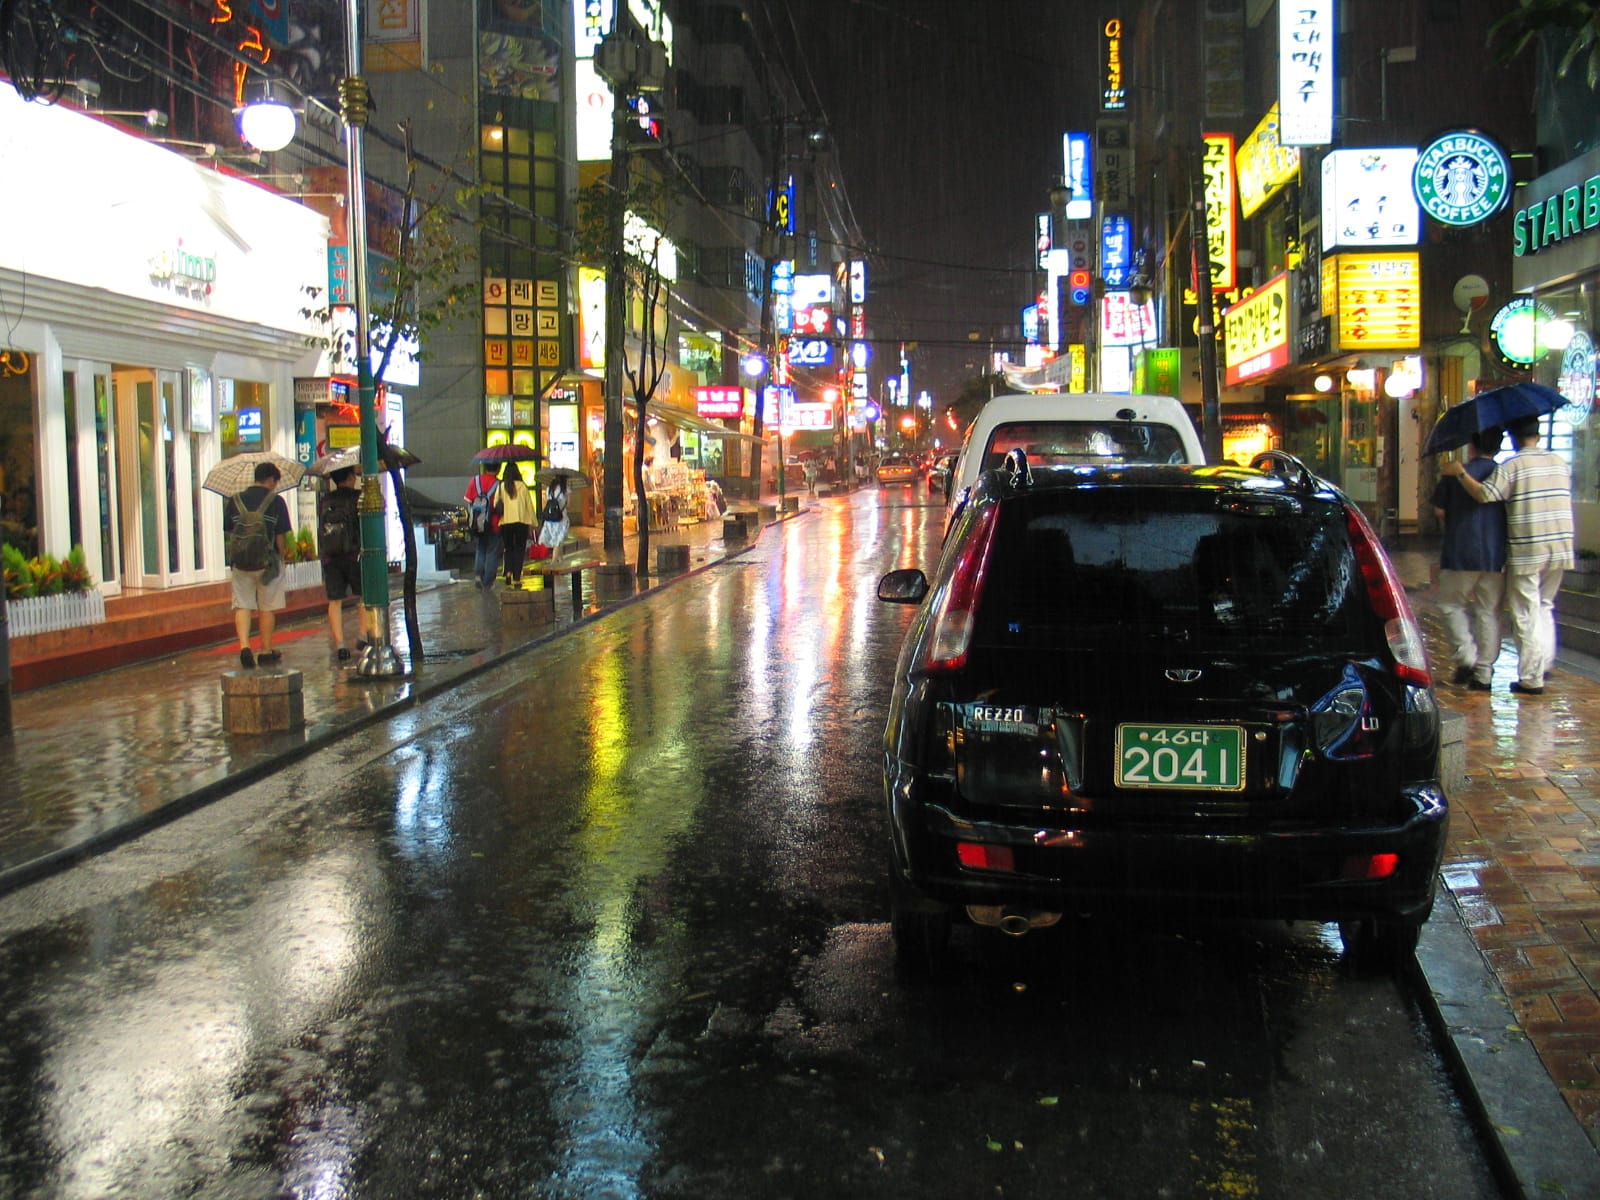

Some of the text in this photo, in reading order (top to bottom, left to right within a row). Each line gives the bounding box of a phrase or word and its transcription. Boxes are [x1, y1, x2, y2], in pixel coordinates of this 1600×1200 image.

[1420, 136, 1503, 178] STARBUCKS
[1427, 197, 1493, 221] COFFEE
[1513, 174, 1600, 257] STARB
[1105, 234, 1123, 285] 백두산
[333, 249, 349, 302] 노래방
[514, 284, 556, 302] 레드
[1350, 288, 1411, 304] 동동주
[1508, 299, 1524, 311] POP
[514, 312, 556, 331] 망고
[1351, 306, 1412, 323] 소주
[490, 343, 529, 361] 만화
[974, 706, 1023, 722] REZZO
[1151, 729, 1210, 745] 46다
[1123, 747, 1228, 784] 2041
